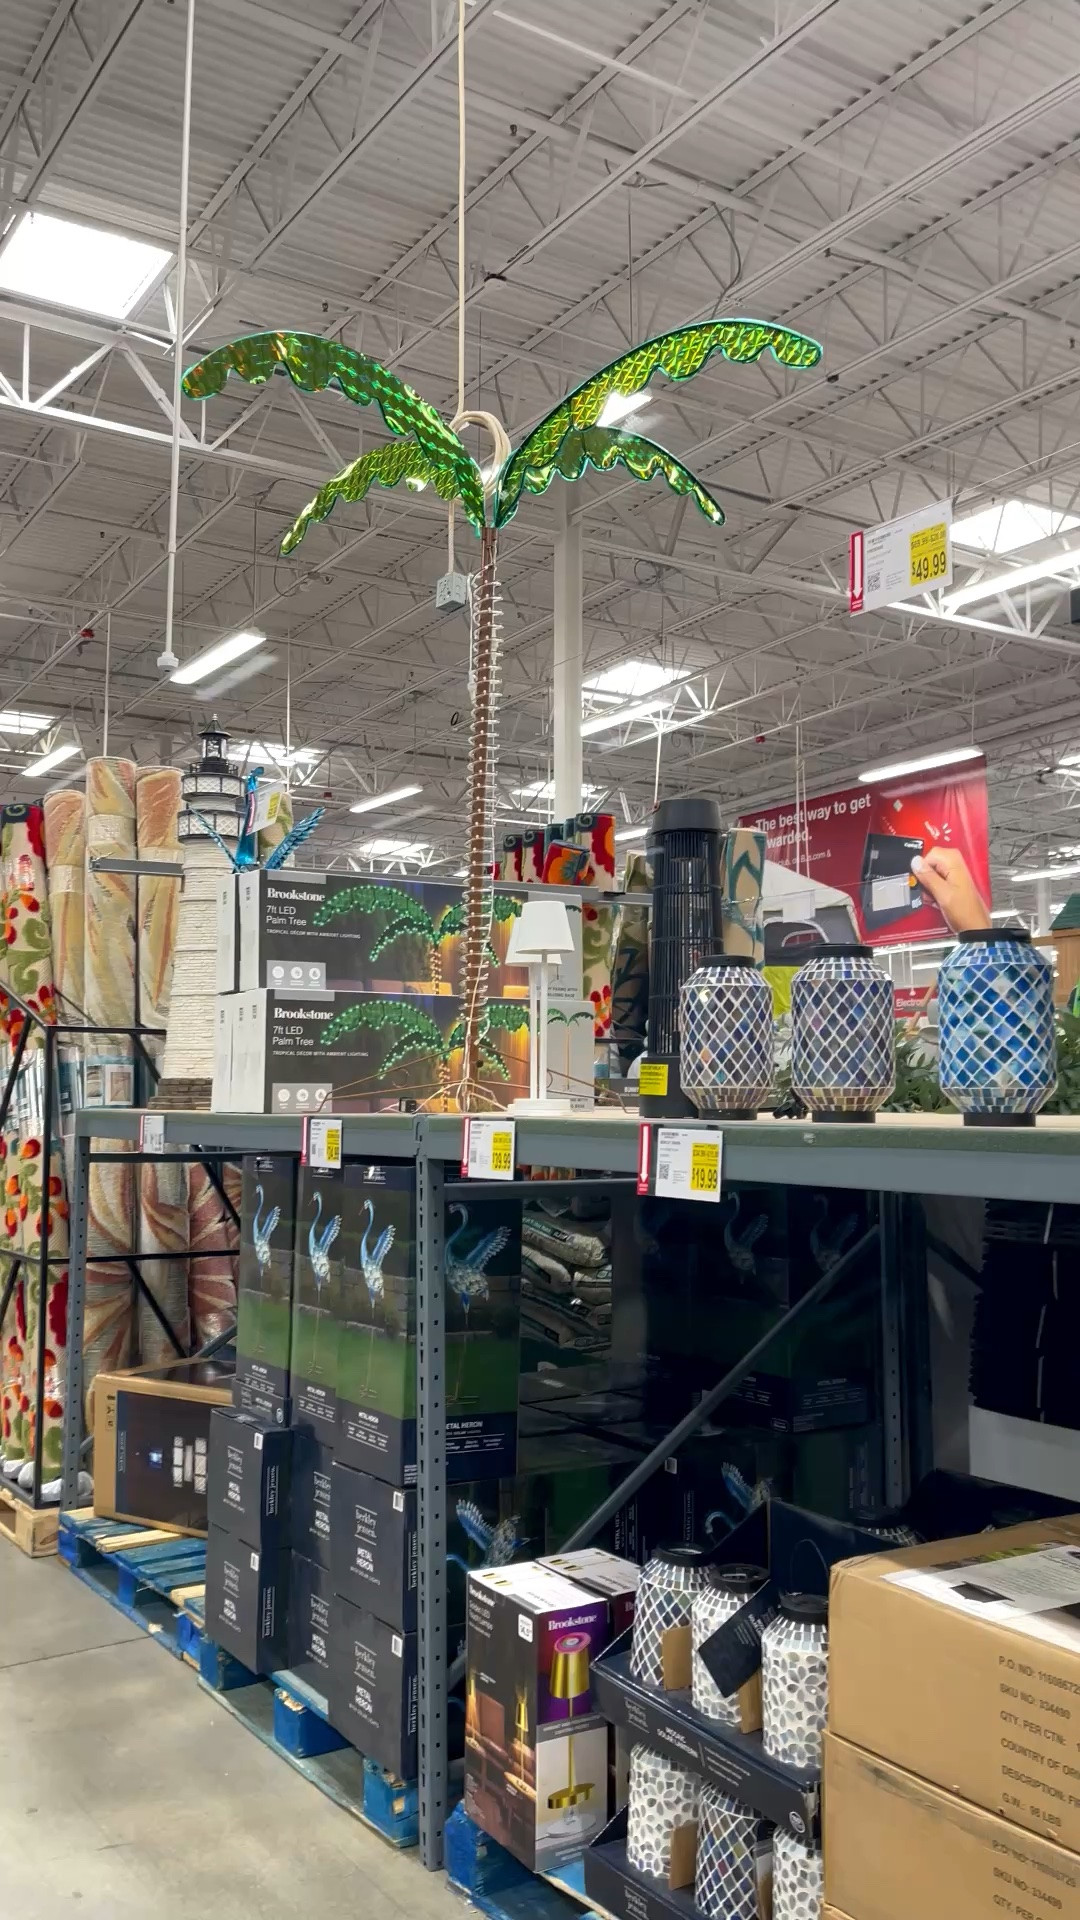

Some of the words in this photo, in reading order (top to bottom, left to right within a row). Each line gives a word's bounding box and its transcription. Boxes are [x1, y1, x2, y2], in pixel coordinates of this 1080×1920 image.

[911, 551, 947, 580] $49.99
[756, 818, 776, 832] The
[779, 814, 806, 828] best
[807, 808, 831, 822] way
[833, 801, 847, 814] to
[850, 793, 871, 814] get
[767, 828, 812, 849] warded.
[267, 887, 326, 901] Brookstone
[266, 905, 277, 914] 7ft
[278, 905, 296, 915] LED
[266, 915, 286, 925] Palm
[288, 916, 307, 926] Tree
[896, 998, 920, 1007] Electro
[274, 1006, 334, 1020] Brookstone
[273, 1025, 284, 1035] 7ft
[285, 1026, 303, 1035] LED
[272, 1036, 293, 1046] Palm
[295, 1037, 314, 1046] Tree
[692, 1166, 718, 1190] $19.99
[446, 1422, 460, 1430] ETAL
[461, 1420, 483, 1429] HERON
[548, 1614, 598, 1631] Brookstone
[1000, 1683, 1019, 1698] SKU
[1023, 1719, 1042, 1736] PER
[1001, 1738, 1045, 1765] COUNTRY
[1046, 1758, 1061, 1770] OF
[1043, 1810, 1062, 1827] LBS
[993, 1867, 1012, 1884] SKU
